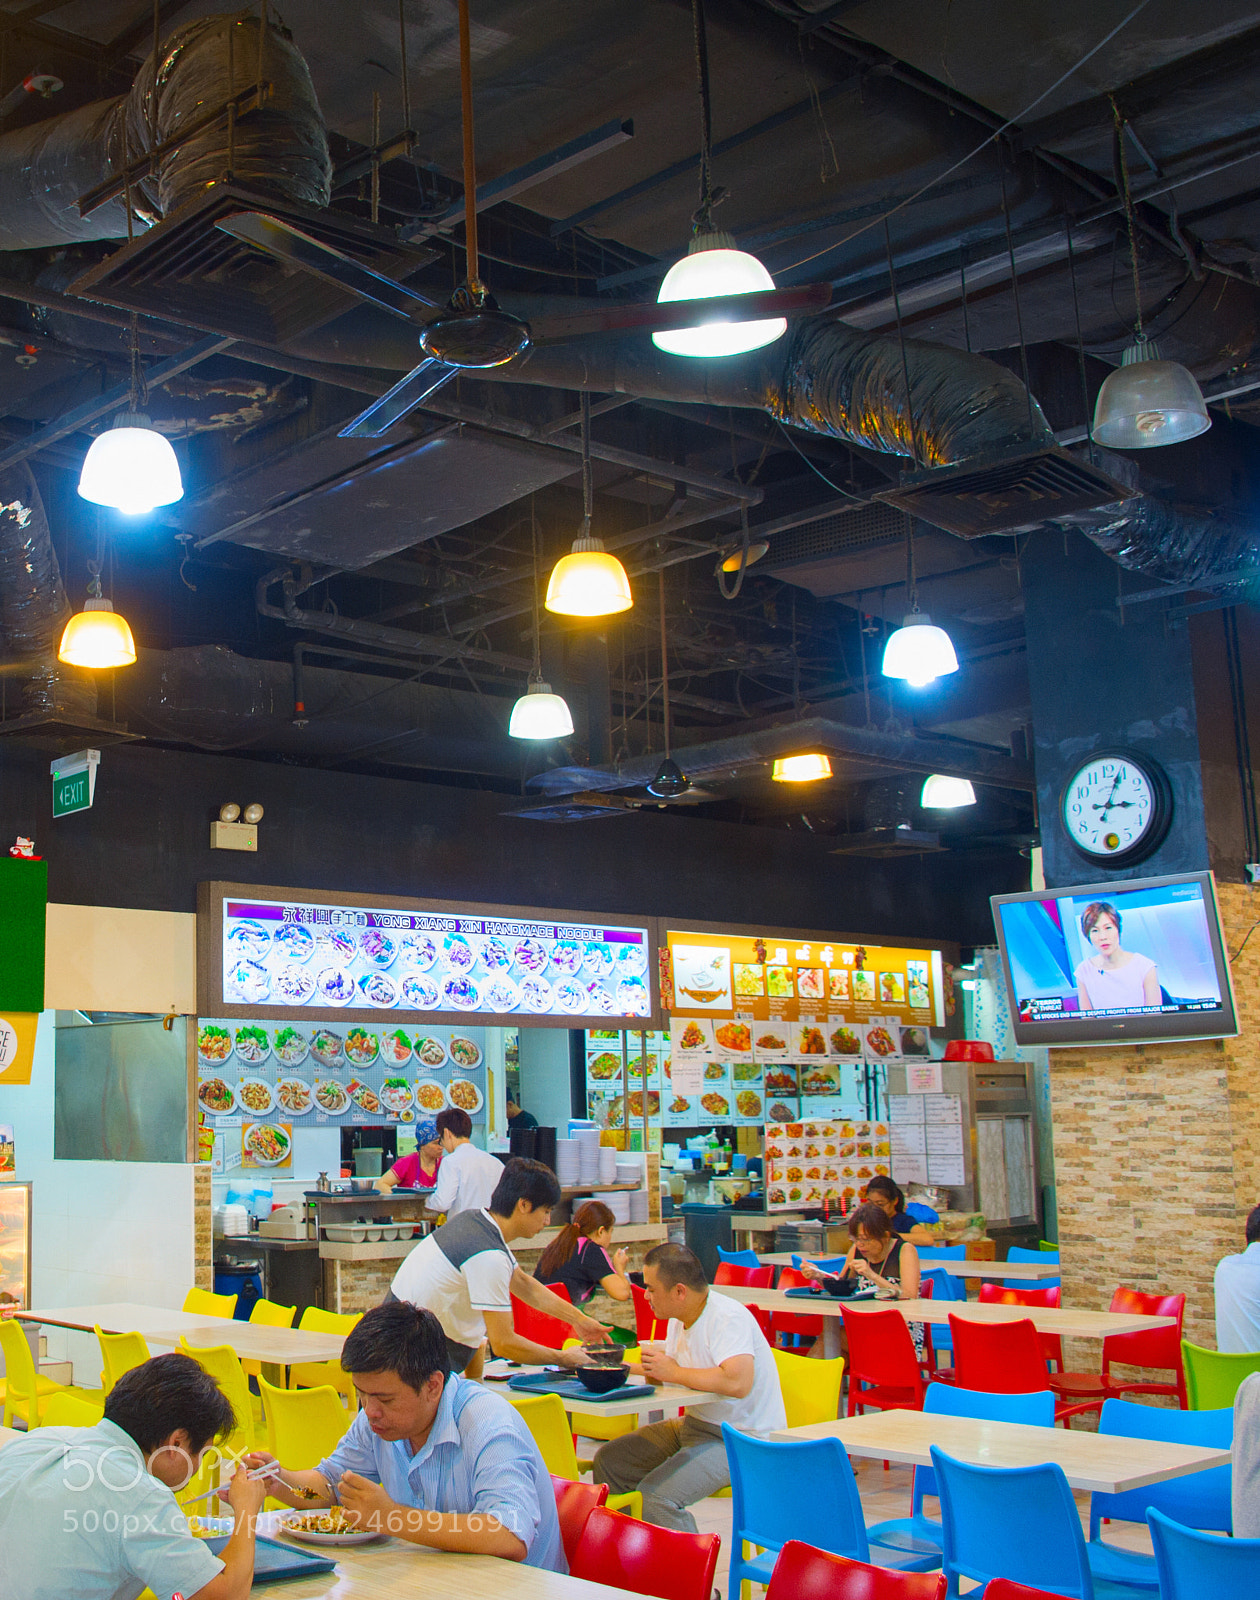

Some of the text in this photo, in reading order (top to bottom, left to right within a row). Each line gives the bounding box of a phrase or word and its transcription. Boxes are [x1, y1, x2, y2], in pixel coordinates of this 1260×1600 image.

[1088, 771, 1098, 785] 11
[1103, 765, 1114, 778] 12
[1132, 778, 1142, 791] 2
[65, 781, 84, 806] EXIT
[1077, 786, 1089, 799] 10
[1139, 795, 1148, 809] 3
[1072, 803, 1082, 816] 9
[1079, 820, 1088, 833] 8
[1134, 814, 1142, 826] 4
[1092, 830, 1099, 843] 7
[1123, 828, 1132, 841] 5
[373, 914, 604, 942] YONG XIANG XIN HANDMADE NOODLE
[1143, 1004, 1160, 1012] MAJOR
[1161, 1004, 1179, 1012] BANKS
